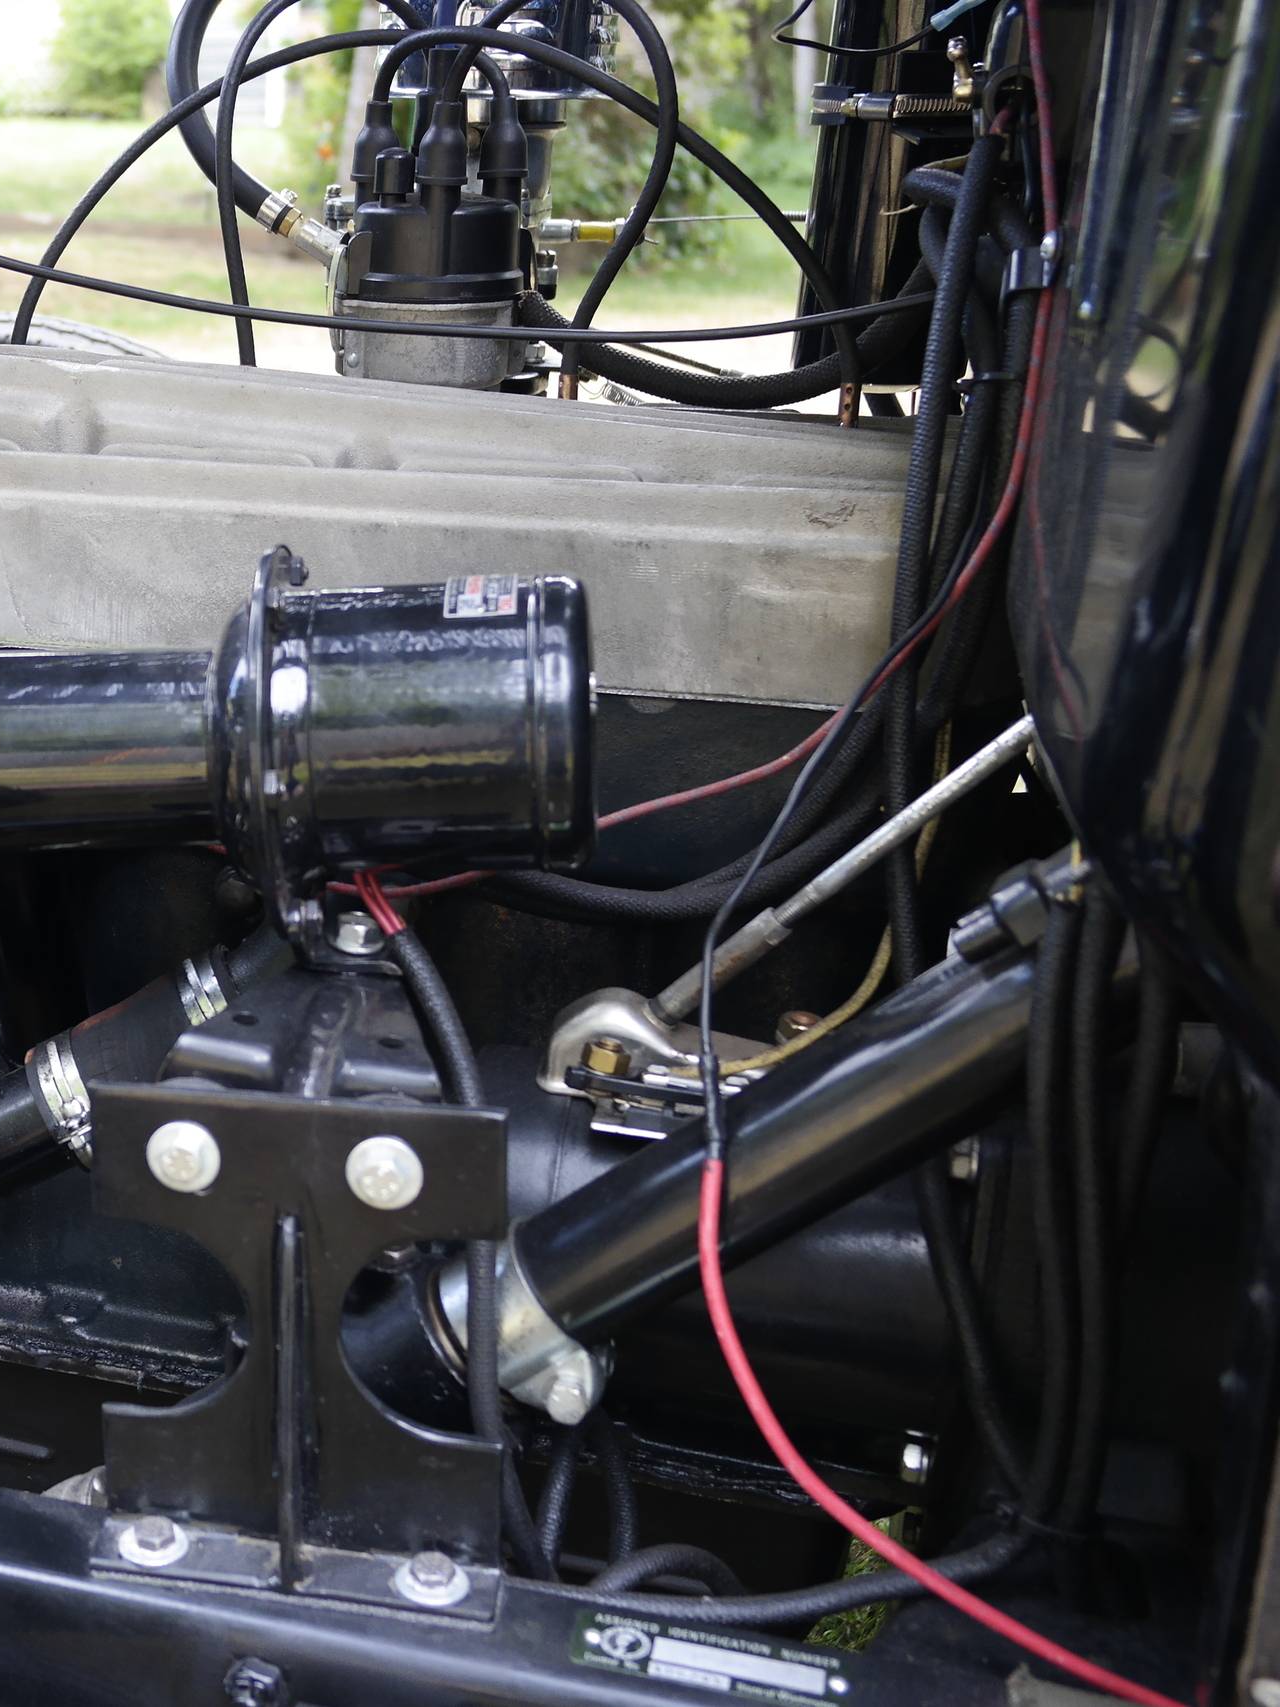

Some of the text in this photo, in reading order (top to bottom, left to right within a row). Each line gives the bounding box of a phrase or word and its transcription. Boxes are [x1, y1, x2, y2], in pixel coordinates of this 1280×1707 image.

[594, 1612, 840, 1671] ASSIGNED IDENTIFICATION NUMBER
